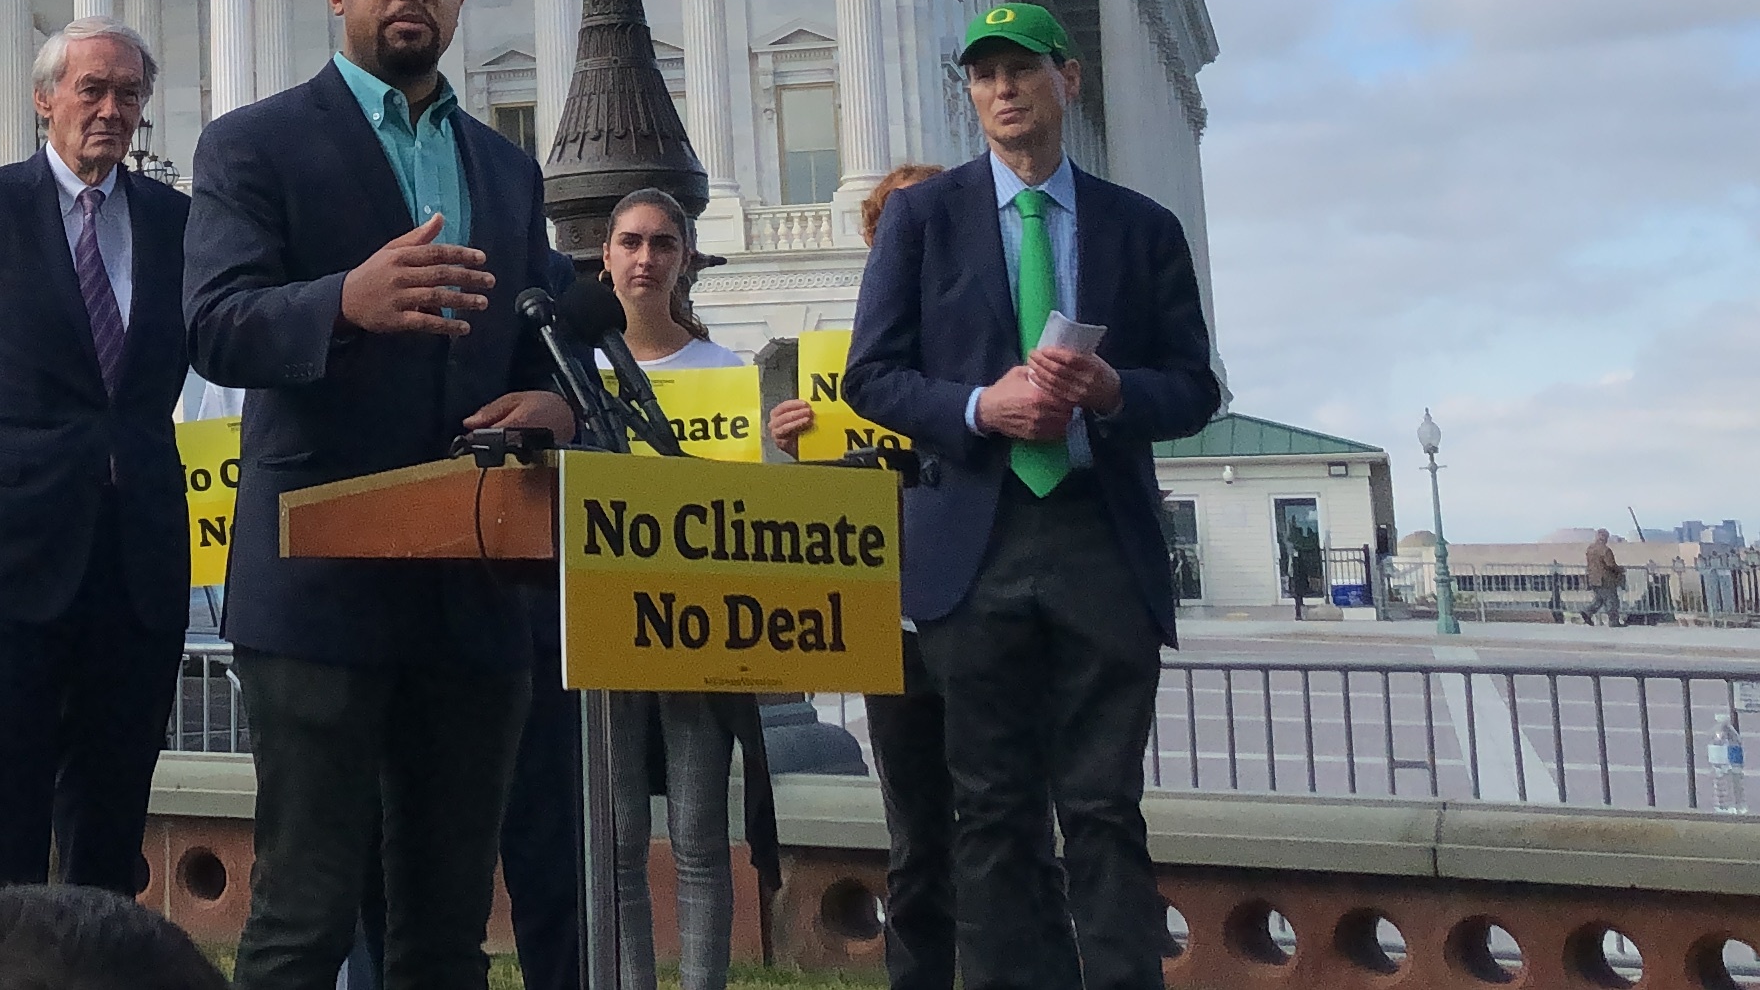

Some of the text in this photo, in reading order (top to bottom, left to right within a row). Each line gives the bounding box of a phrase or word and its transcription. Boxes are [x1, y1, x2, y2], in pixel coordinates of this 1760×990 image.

[810, 373, 839, 402] N
[198, 516, 234, 547] N
[584, 499, 886, 567] No Climate
[634, 592, 846, 653] No Deal
